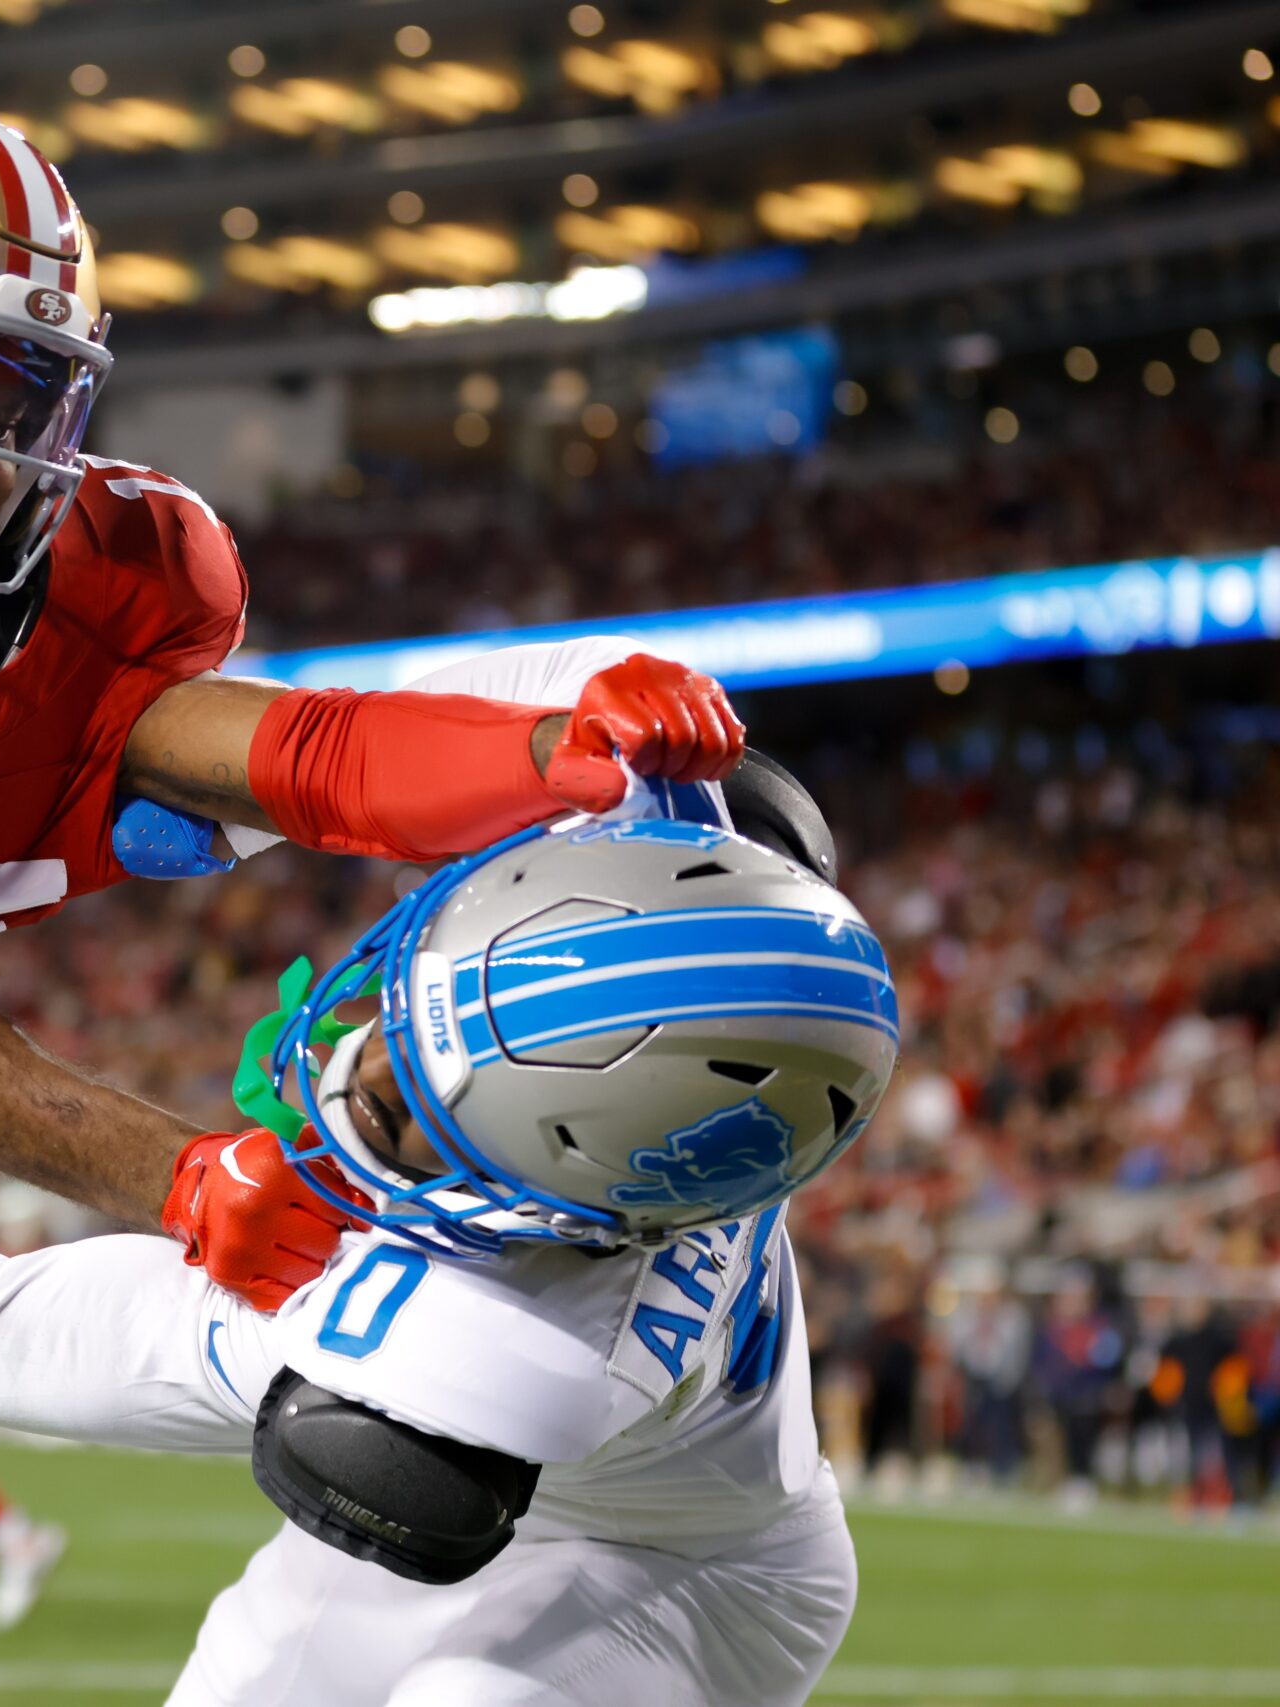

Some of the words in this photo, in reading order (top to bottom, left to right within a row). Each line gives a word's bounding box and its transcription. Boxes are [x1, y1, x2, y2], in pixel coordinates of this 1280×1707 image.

[427, 983, 455, 1056] LIONS
[315, 1241, 434, 1363] 0
[631, 1221, 741, 1385] AR
